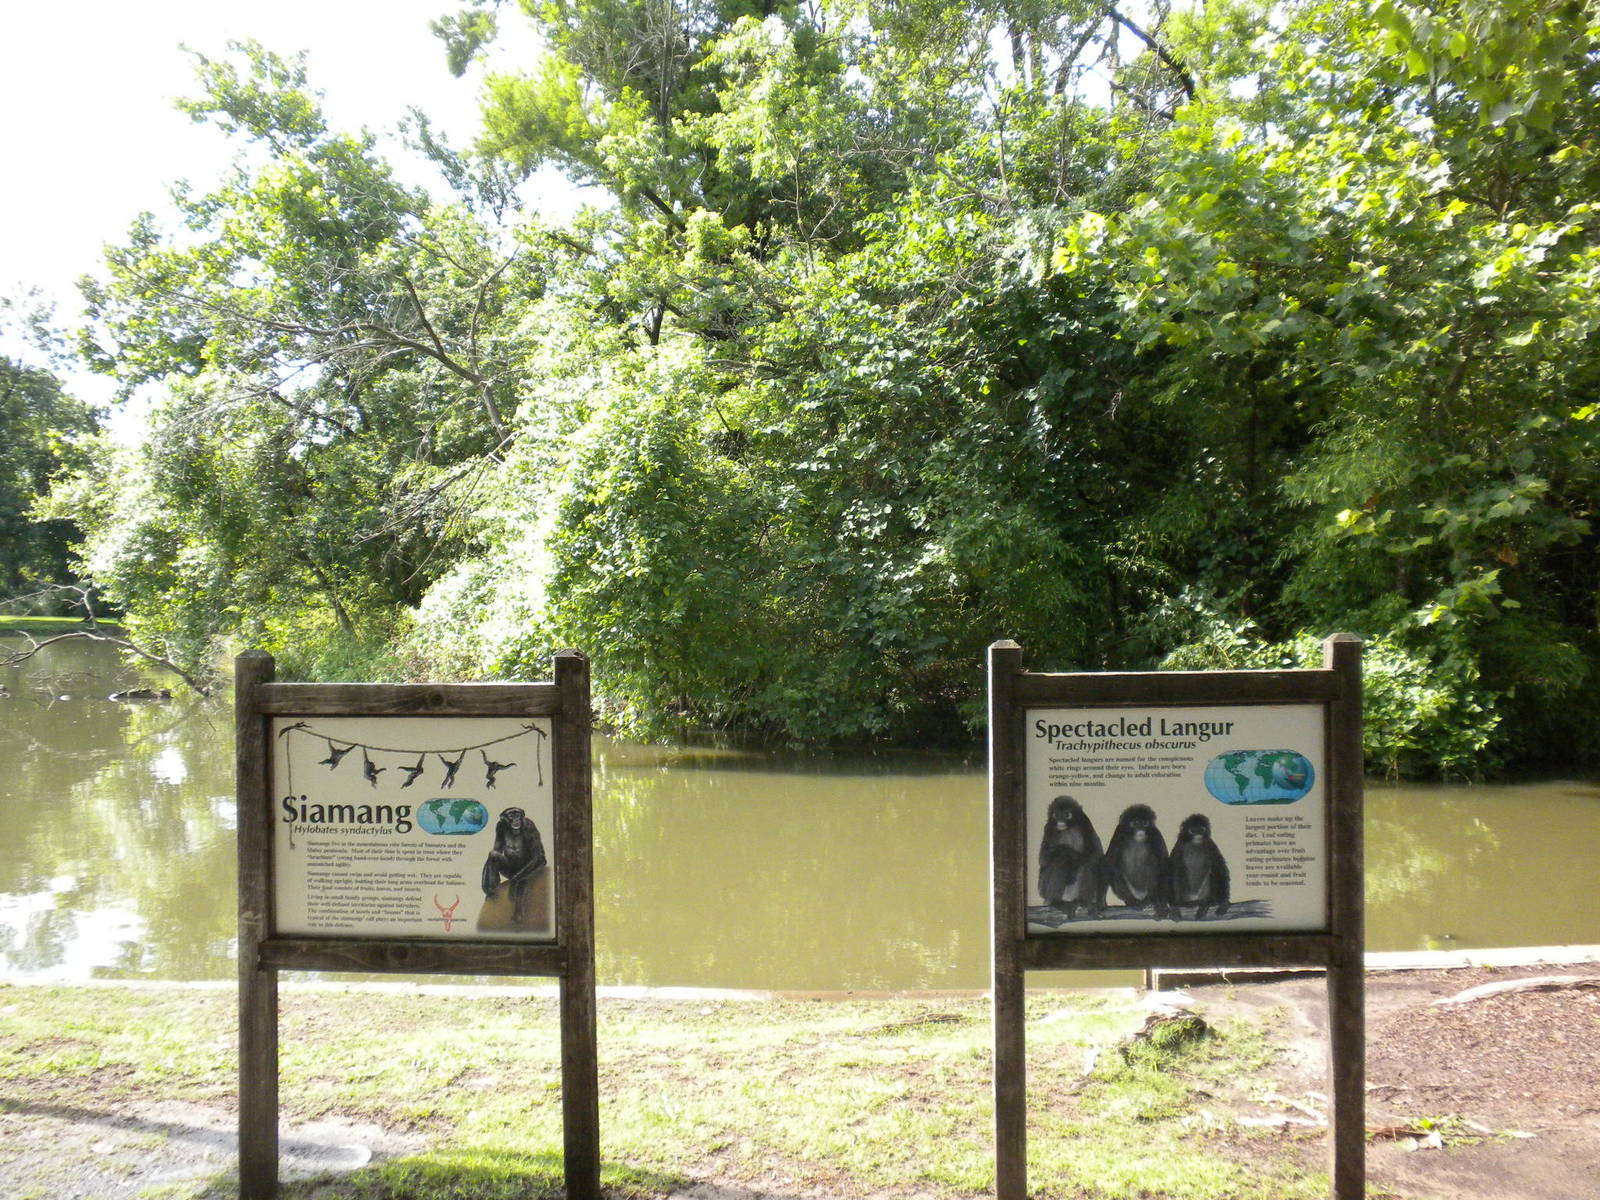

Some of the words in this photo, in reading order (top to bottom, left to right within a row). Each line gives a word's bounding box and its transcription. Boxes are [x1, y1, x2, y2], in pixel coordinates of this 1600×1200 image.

[1035, 717, 1152, 743] Spectacled
[1160, 718, 1234, 742] Langur
[1055, 740, 1142, 753] Trachypithecus
[1145, 739, 1197, 750] obscurus
[282, 795, 412, 834] Siamang
[294, 825, 338, 835] Hylobates
[340, 825, 393, 837] syndactylus
